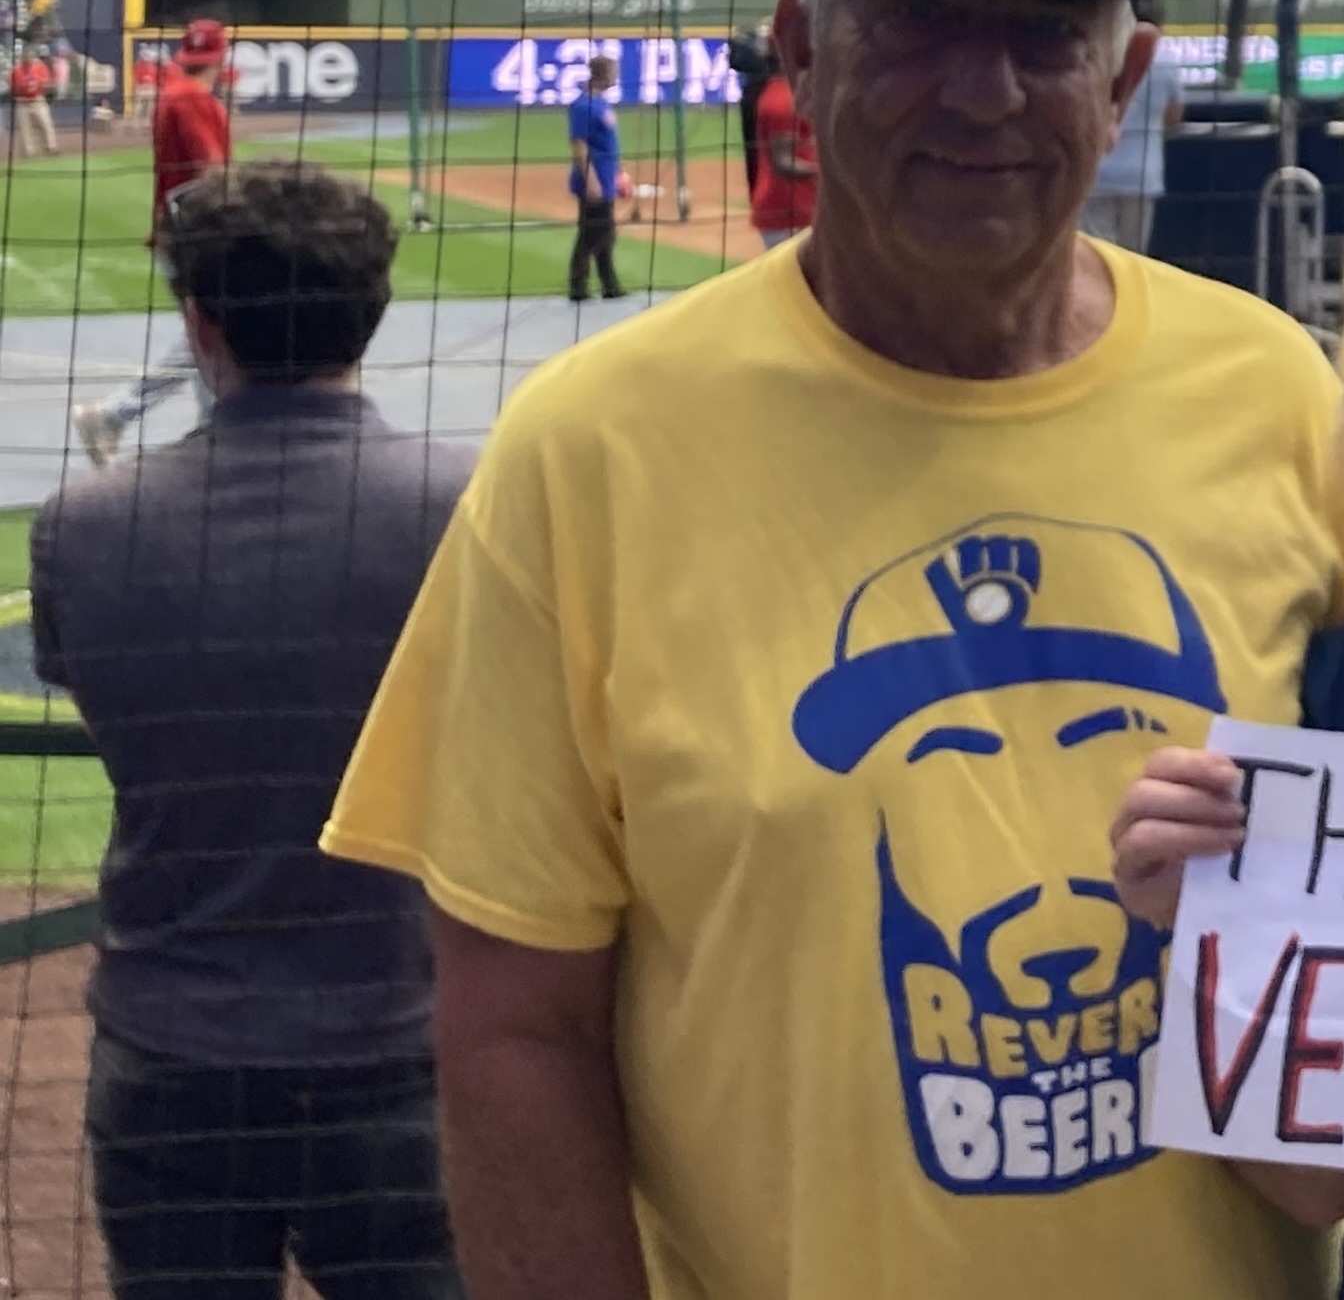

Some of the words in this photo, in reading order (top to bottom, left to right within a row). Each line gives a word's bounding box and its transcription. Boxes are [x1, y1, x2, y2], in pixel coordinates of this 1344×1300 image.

[637, 37, 743, 107] PM
[903, 963, 1162, 1079] REVER
[918, 1045, 1160, 1181] BEER
[1032, 1058, 1113, 1093] THE
